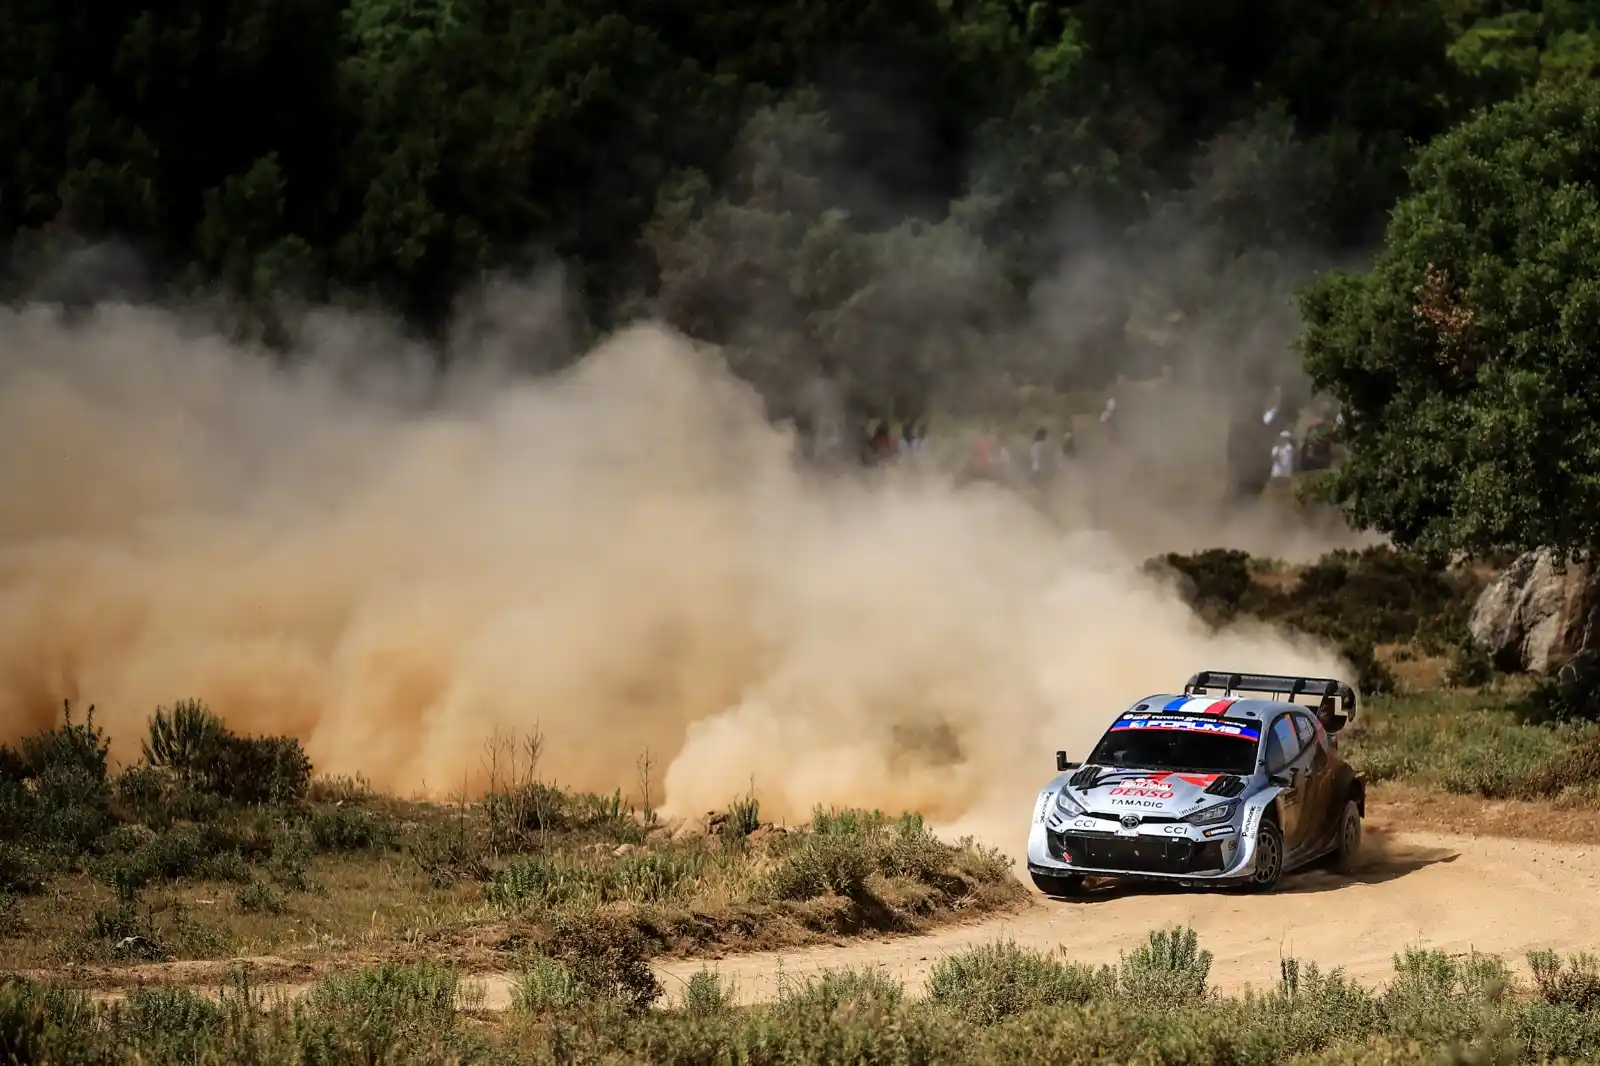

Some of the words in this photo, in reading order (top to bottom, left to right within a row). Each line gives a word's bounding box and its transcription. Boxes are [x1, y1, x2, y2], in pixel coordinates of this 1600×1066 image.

[1108, 788, 1174, 799] DENSO
[1111, 799, 1164, 809] TAMADIC
[1074, 820, 1097, 828] CCI
[1163, 825, 1188, 835] CCI
